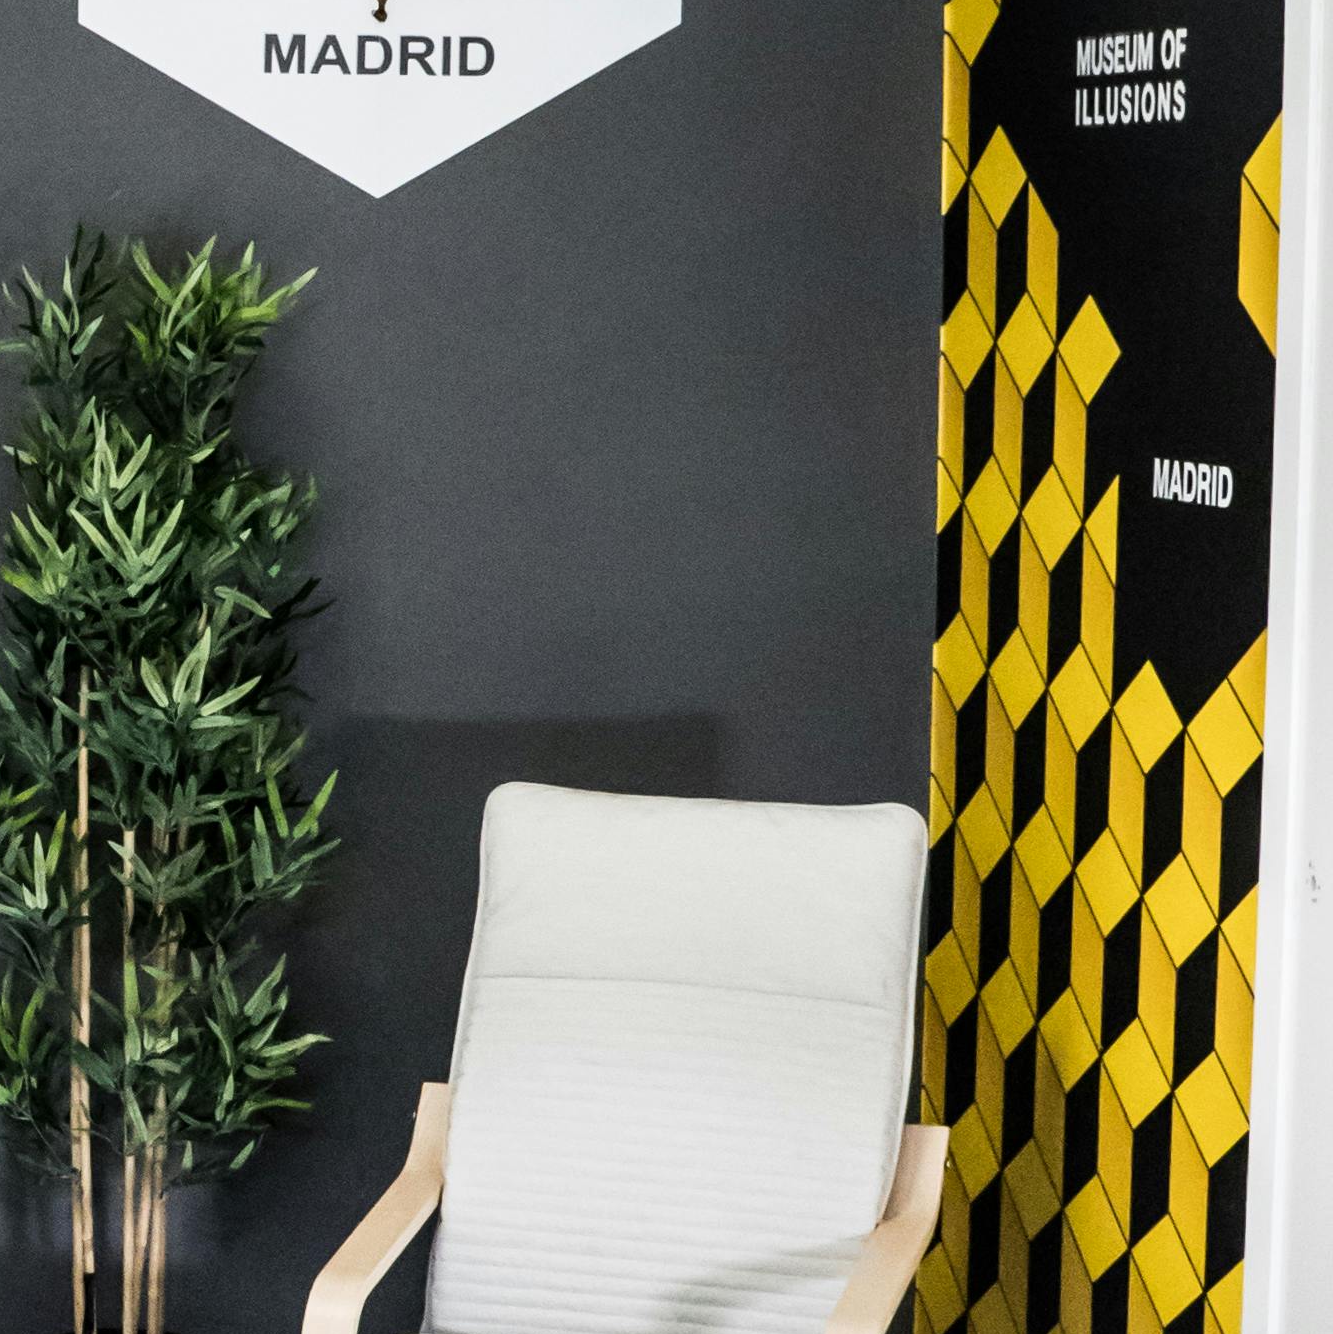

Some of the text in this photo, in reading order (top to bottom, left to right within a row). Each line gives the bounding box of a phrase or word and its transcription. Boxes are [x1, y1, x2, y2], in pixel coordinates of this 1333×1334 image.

[263, 33, 495, 78] MADRID
[1076, 27, 1188, 77] MUSEUM OF
[1075, 79, 1187, 127] ILLUSIONS
[1152, 457, 1234, 509] MADRID
